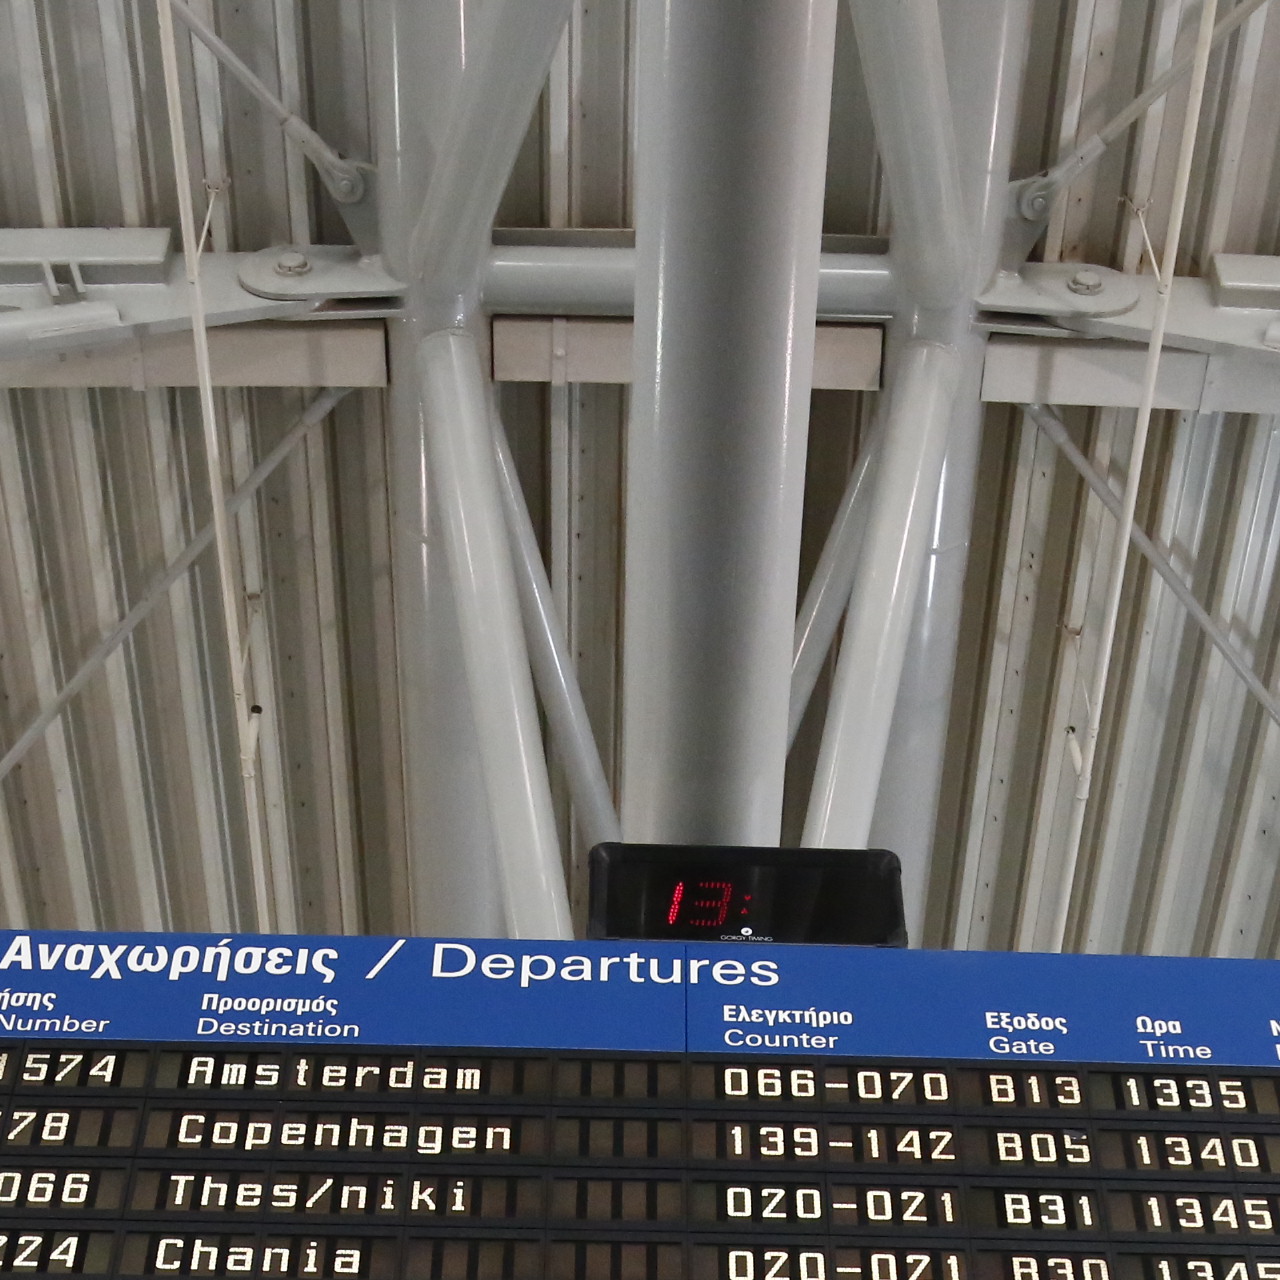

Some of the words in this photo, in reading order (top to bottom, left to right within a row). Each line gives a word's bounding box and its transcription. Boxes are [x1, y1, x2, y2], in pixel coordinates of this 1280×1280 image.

[366, 943, 404, 978] /
[432, 944, 780, 987] Departures
[201, 994, 339, 1017] Προορισμός
[723, 1005, 853, 1028] Ελεγκτήριο
[197, 1018, 360, 1038] Destination
[985, 1012, 1068, 1034] Εξοδος
[1135, 1016, 1181, 1036] Ωρα
[724, 1029, 839, 1049] Counter
[988, 1036, 1055, 1054] Gate
[1139, 1041, 1212, 1059] Time
[188, 1057, 480, 1089] Amsterdam
[725, 1069, 948, 1100] 066-070
[990, 1075, 1080, 1103] B13
[1127, 1079, 1246, 1108] 1335
[179, 1115, 510, 1154] Copenhagen
[732, 1126, 955, 1159] 139-142
[997, 1133, 1090, 1162] B05
[1138, 1137, 1259, 1166] 1340
[171, 1176, 464, 1210] Thes/niki
[727, 1188, 953, 1221] 020-021
[1005, 1194, 1092, 1225] B31
[1148, 1197, 1272, 1229] 1345
